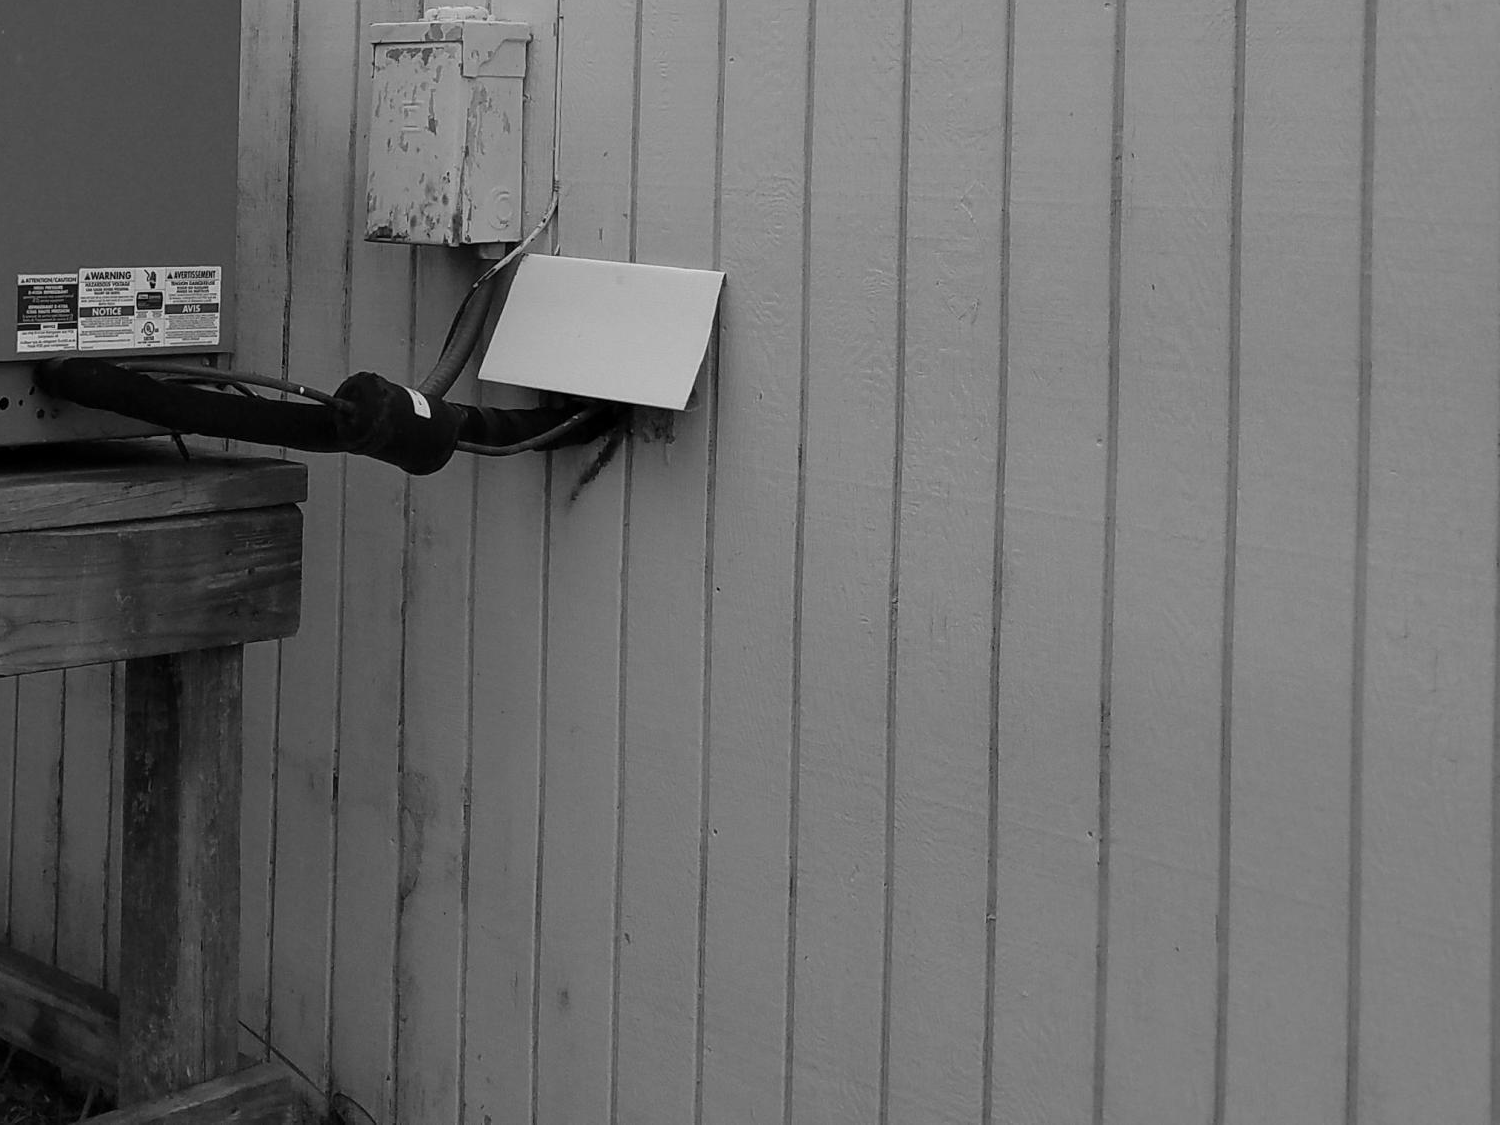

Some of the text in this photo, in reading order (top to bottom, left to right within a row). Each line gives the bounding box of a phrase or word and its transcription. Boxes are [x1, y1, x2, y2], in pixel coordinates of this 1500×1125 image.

[90, 271, 132, 281] WARNING
[92, 307, 122, 316] NOTICE
[182, 304, 201, 313] AVIS
